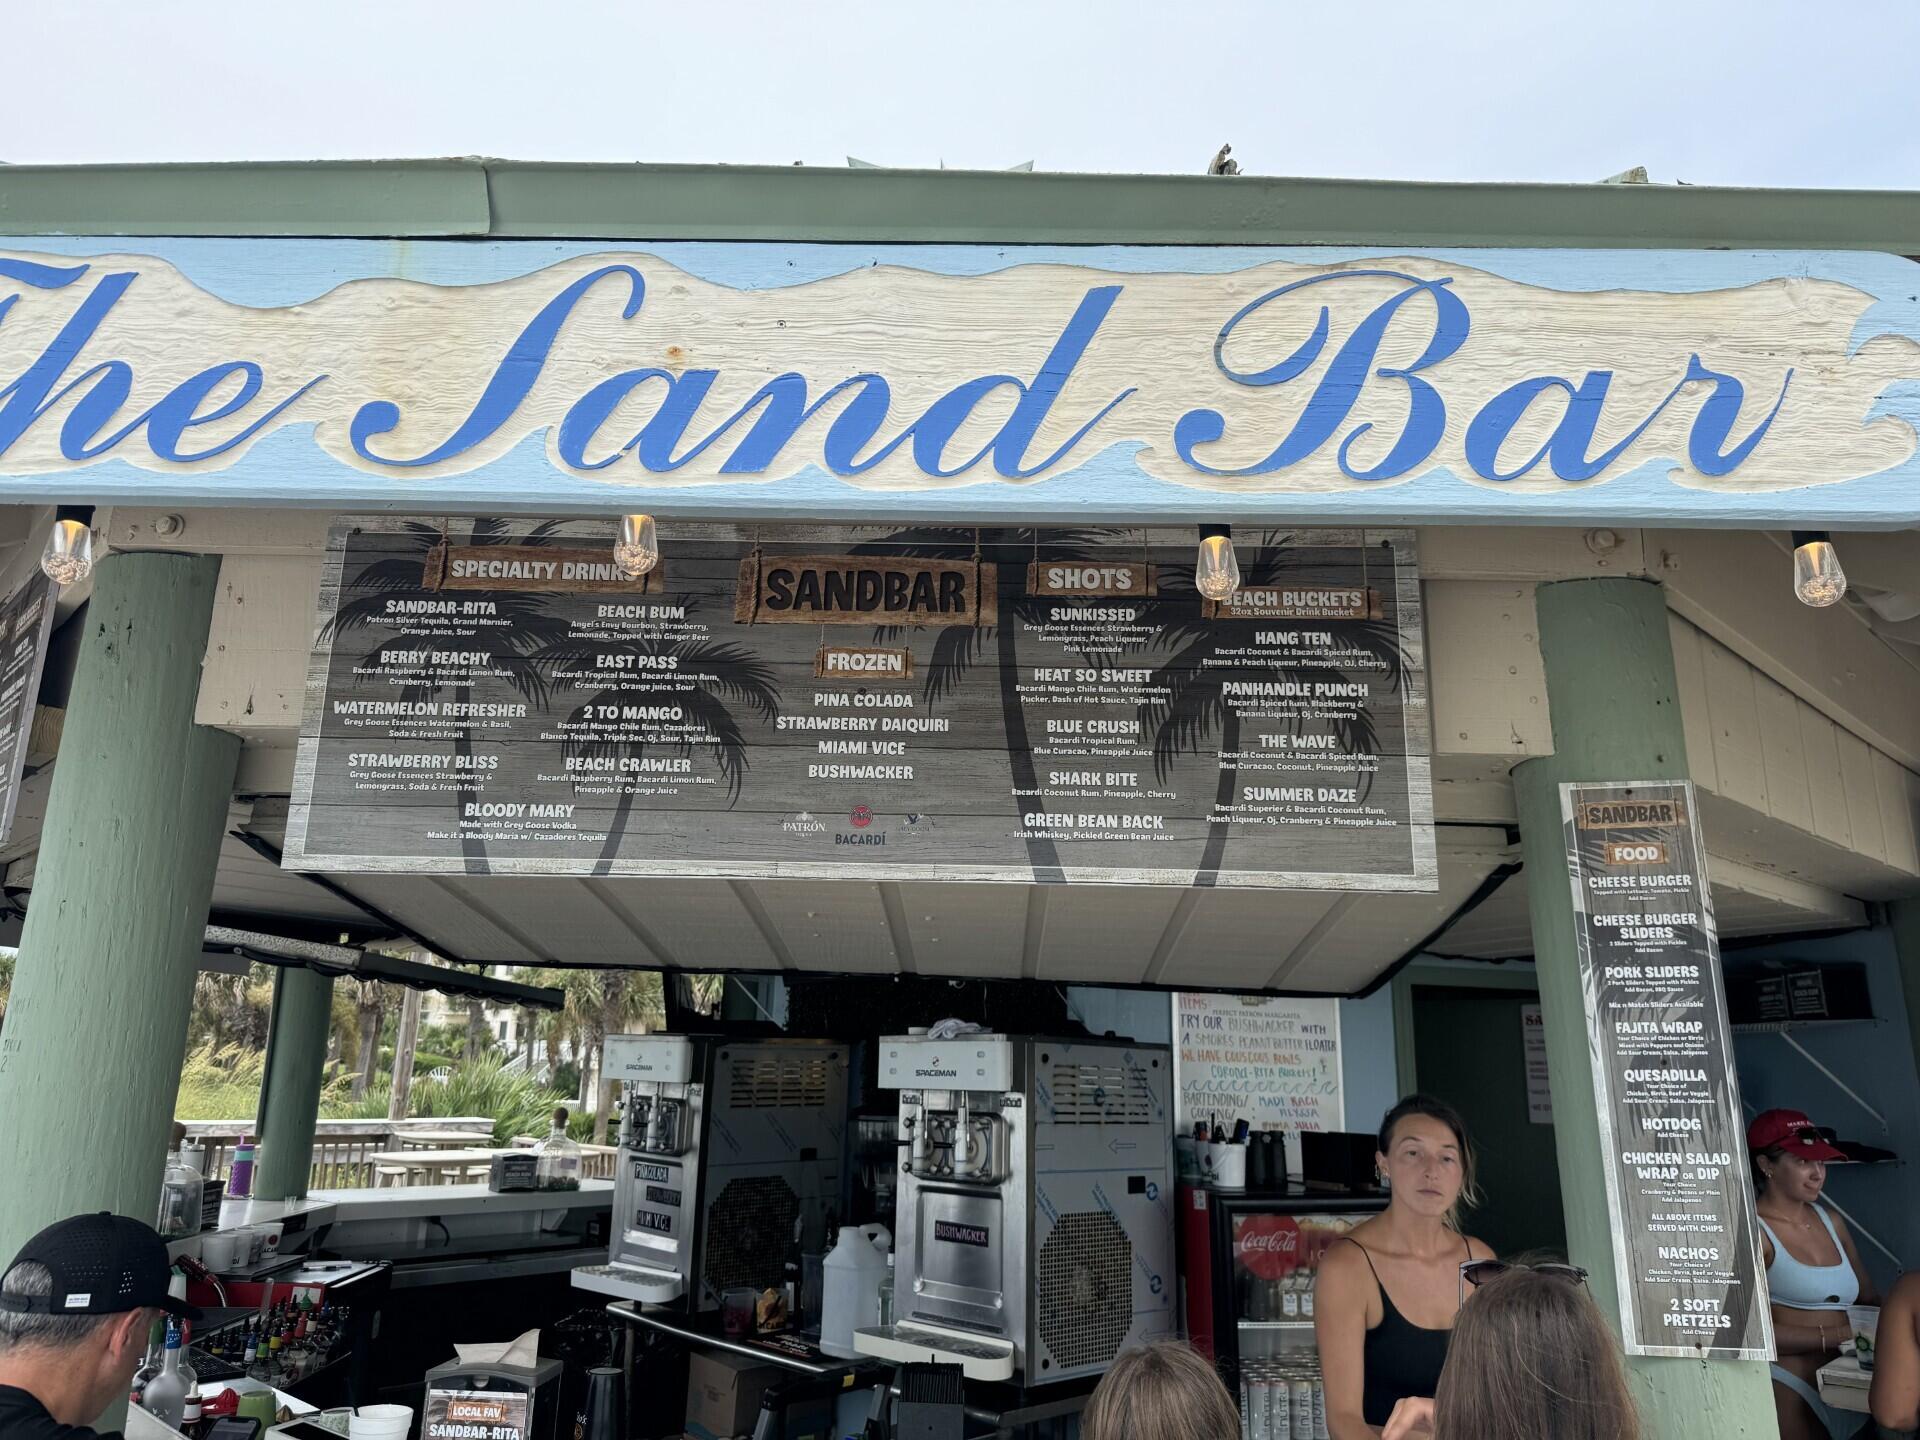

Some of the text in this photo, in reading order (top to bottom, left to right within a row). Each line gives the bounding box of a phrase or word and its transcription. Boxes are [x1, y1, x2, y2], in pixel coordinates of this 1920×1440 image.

[350, 263, 1138, 478] Sand
[1174, 269, 1795, 481] Bar
[452, 560, 556, 580] SPECIALTY
[1048, 568, 1132, 590] SHOTS
[765, 568, 966, 612] SANDBAR
[1282, 591, 1362, 607] BUCKETS
[386, 600, 497, 615] SANDBAR-RITA
[598, 605, 685, 619] BEACH BUM
[1231, 607, 1354, 617] 32oz Souvenir Drink Bucket
[366, 616, 514, 627] Patron Silver Tequila, Grand Marnier,
[1050, 608, 1136, 622] SUNKISSED
[400, 627, 476, 636] Orange Juice, Sour
[568, 631, 610, 640] Lemonade,
[613, 632, 642, 641] Topped
[643, 632, 662, 640] with
[664, 633, 690, 641] Ginger
[1255, 631, 1331, 645] HANG TEN
[1063, 645, 1123, 653] Pink Lemonade
[381, 651, 491, 666] BERRY BEACHY
[596, 655, 678, 670] EAST PASS
[827, 654, 901, 672] FROZEN
[1034, 668, 1152, 683] HEAT SO SWEET
[1016, 685, 1171, 694] Bacardi Mango Chile Rum, Watermelon
[1222, 681, 1369, 697] PANHANDLE PUNCH
[814, 693, 913, 708] PINA COLADA
[333, 701, 526, 718] WATERMELON REFRESHER
[583, 705, 682, 721] 2 TO MANGO
[777, 716, 949, 733] STRAWBERRY DAIQUIRI
[1047, 720, 1139, 734] BLUE CRUSH
[818, 741, 906, 755] MIAMI VICE
[1259, 734, 1336, 749] THE WAVE
[349, 753, 498, 770] STRAWBERRY BLISS
[566, 757, 691, 772] BEACH CRAWLER
[809, 765, 913, 780] BUSHWACKER
[1049, 772, 1138, 786] SHARK BITE
[1244, 787, 1357, 803] SUMMER DAZE
[465, 803, 575, 818] BLOODY MARY
[1589, 804, 1672, 825] SANDBAR
[459, 821, 481, 829] Made
[483, 821, 502, 829] with
[504, 821, 523, 830] Grey
[552, 822, 577, 830] Vodka
[783, 820, 825, 832] PATRÓN
[1024, 813, 1163, 829] GREEN BEAN BACK
[1206, 815, 1231, 823] Peach
[1232, 816, 1266, 825] Liqueur,
[1280, 816, 1323, 826] Cranberry
[1333, 818, 1374, 827] Pineapple
[1375, 818, 1397, 826] Juice
[835, 832, 885, 846] BACARDÍ
[1014, 830, 1174, 841] Irish Whiskey, Pickled Green Bean Juice
[1615, 846, 1658, 861] FOOD
[1589, 874, 1692, 888] CHEESE BURGER
[1593, 913, 1697, 927] CHEESE BURGER
[1620, 926, 1674, 939] SLIDERS
[1605, 965, 1699, 979] PORK SLIDERS
[1181, 1014, 1199, 1028] TRY
[1204, 1015, 1223, 1031] OUR
[1301, 1024, 1326, 1035] WITH
[1615, 1021, 1703, 1034] FAJITA WRAP
[915, 1069, 957, 1078] SPACEMAN
[1624, 1069, 1707, 1083] QUESADILLA
[1642, 1118, 1701, 1130] HOTDOG
[1622, 1152, 1730, 1165] CHICKEN SALAD
[1637, 1167, 1720, 1180] WRAP OR DIP
[1651, 1213, 1665, 1221] ALL
[1693, 1214, 1717, 1222] ITEMS
[935, 1222, 986, 1244] BUSHWACKER
[1647, 1224, 1677, 1232] SERVED
[1678, 1224, 1699, 1232] WITH
[1241, 1231, 1298, 1252] Coca-Cola
[1658, 1247, 1719, 1260] NACHOS
[1670, 1299, 1720, 1312] 2 SOFT
[1664, 1314, 1731, 1328] PRETZELS
[453, 1406, 501, 1419] LOCAL FAV
[429, 1424, 520, 1440] SANDBAR-RITA
